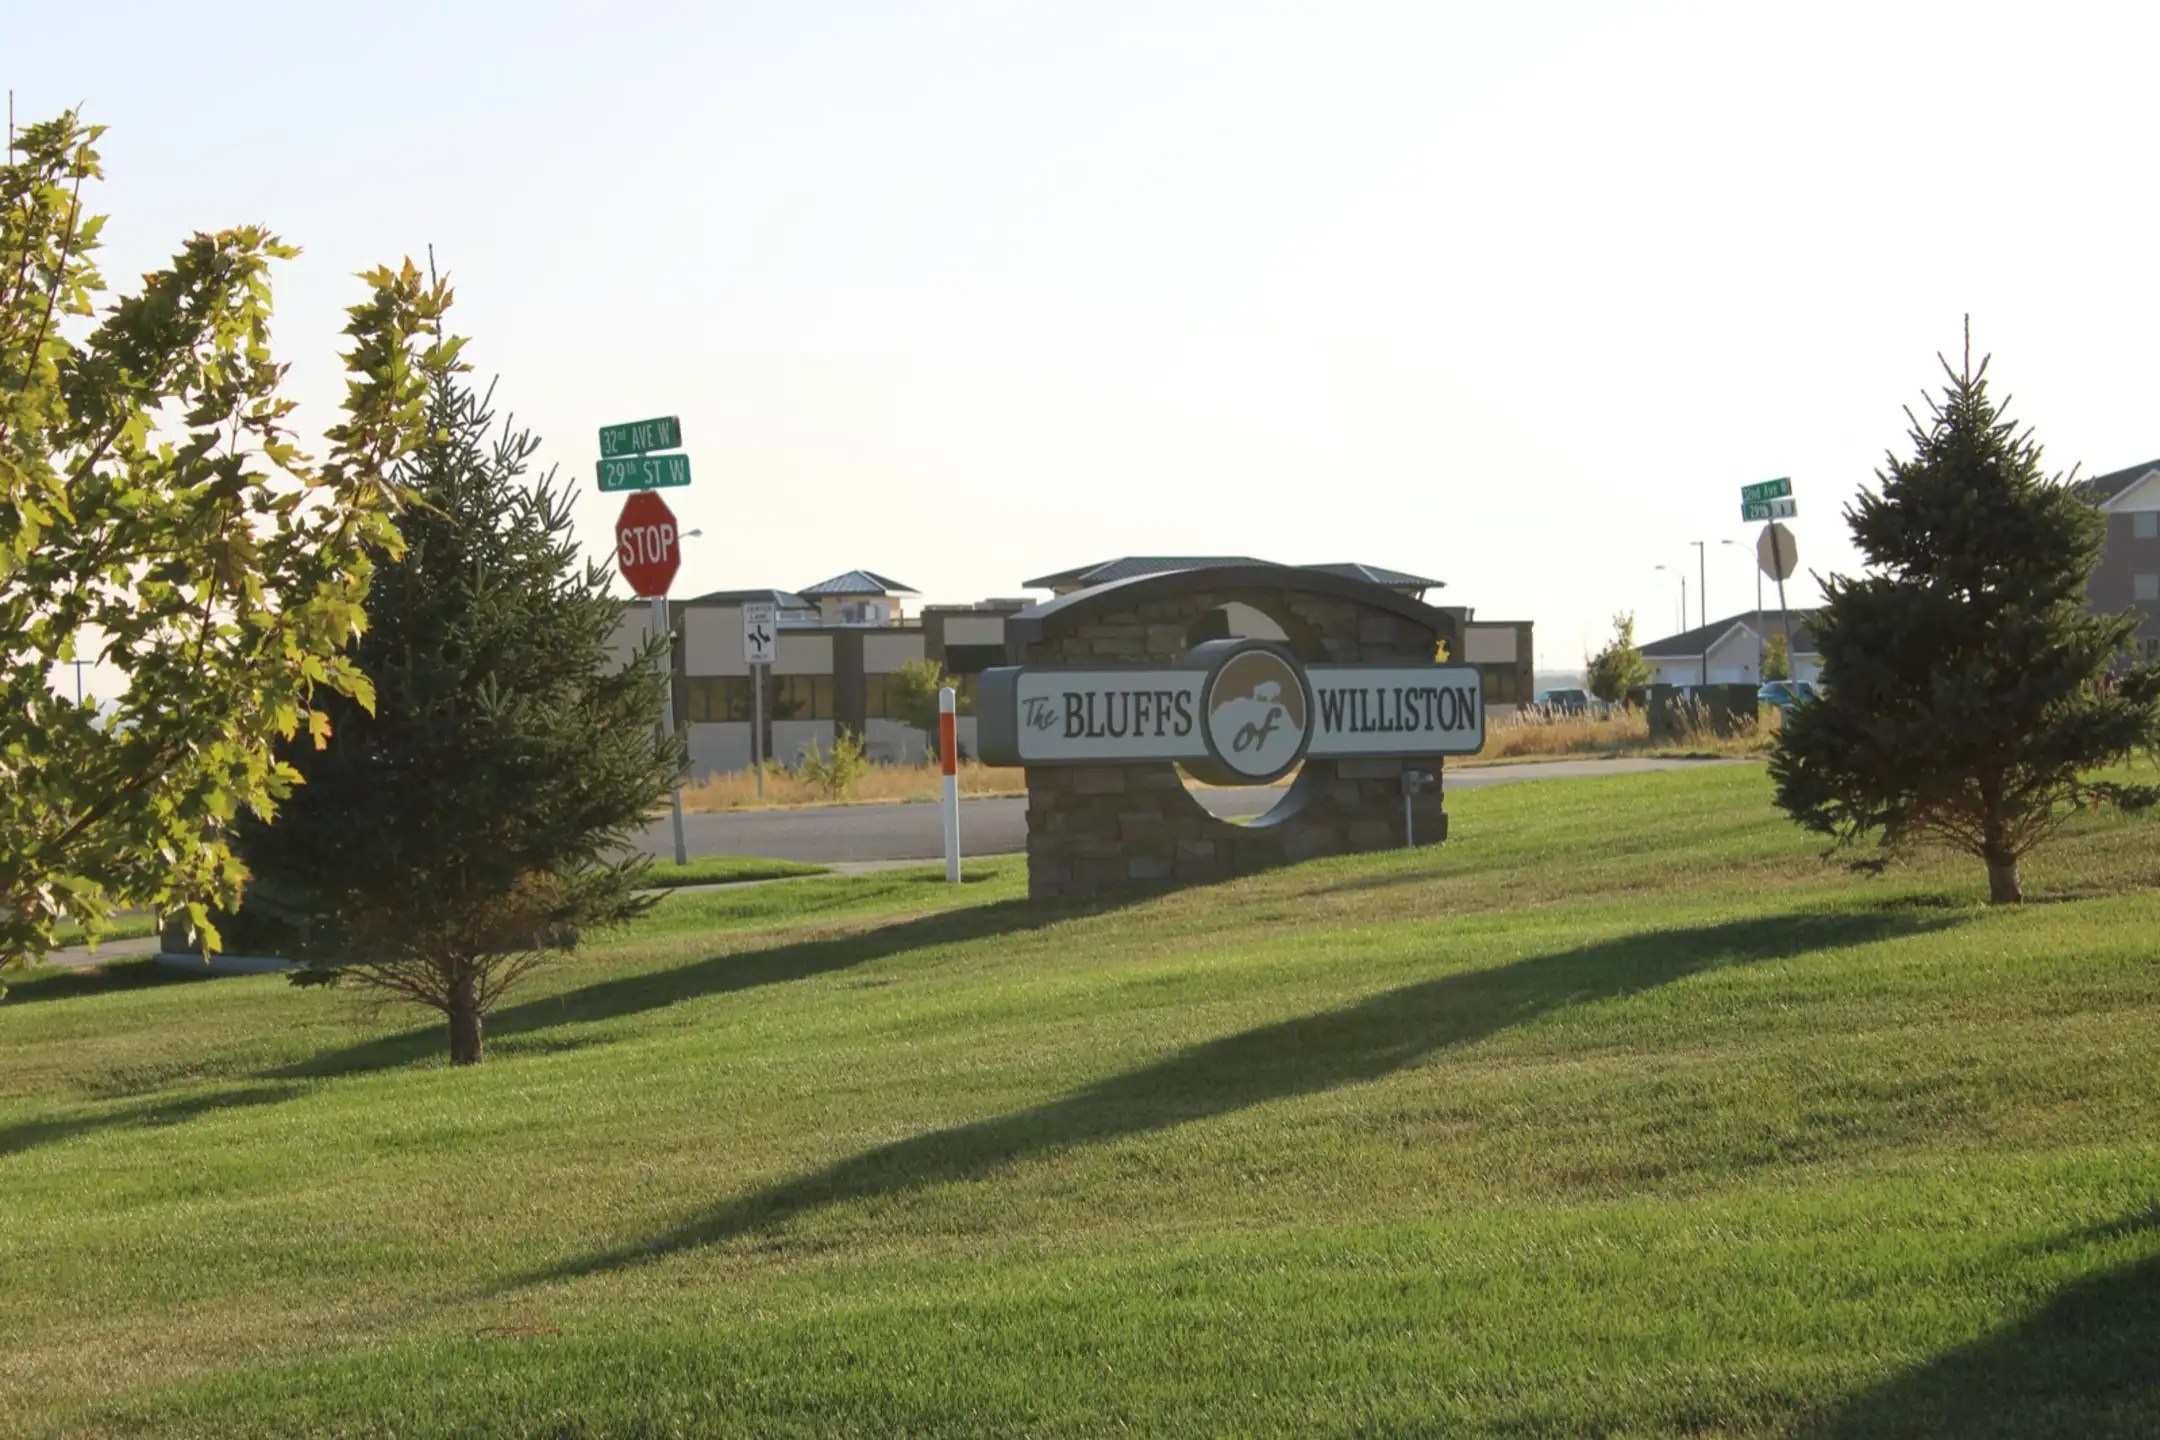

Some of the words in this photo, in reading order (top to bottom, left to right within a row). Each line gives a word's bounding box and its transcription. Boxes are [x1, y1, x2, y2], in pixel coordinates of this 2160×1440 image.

[603, 430, 626, 454] 32nd
[632, 424, 653, 451] AVE
[658, 421, 670, 446] W
[606, 461, 637, 487] 29th
[643, 460, 661, 484] ST
[669, 459, 685, 483] W
[621, 523, 674, 567] STOP
[1021, 696, 1059, 731] The
[1062, 689, 1192, 738] BLUFFS
[1232, 706, 1282, 752] of
[1318, 687, 1476, 733] WILLISTON
